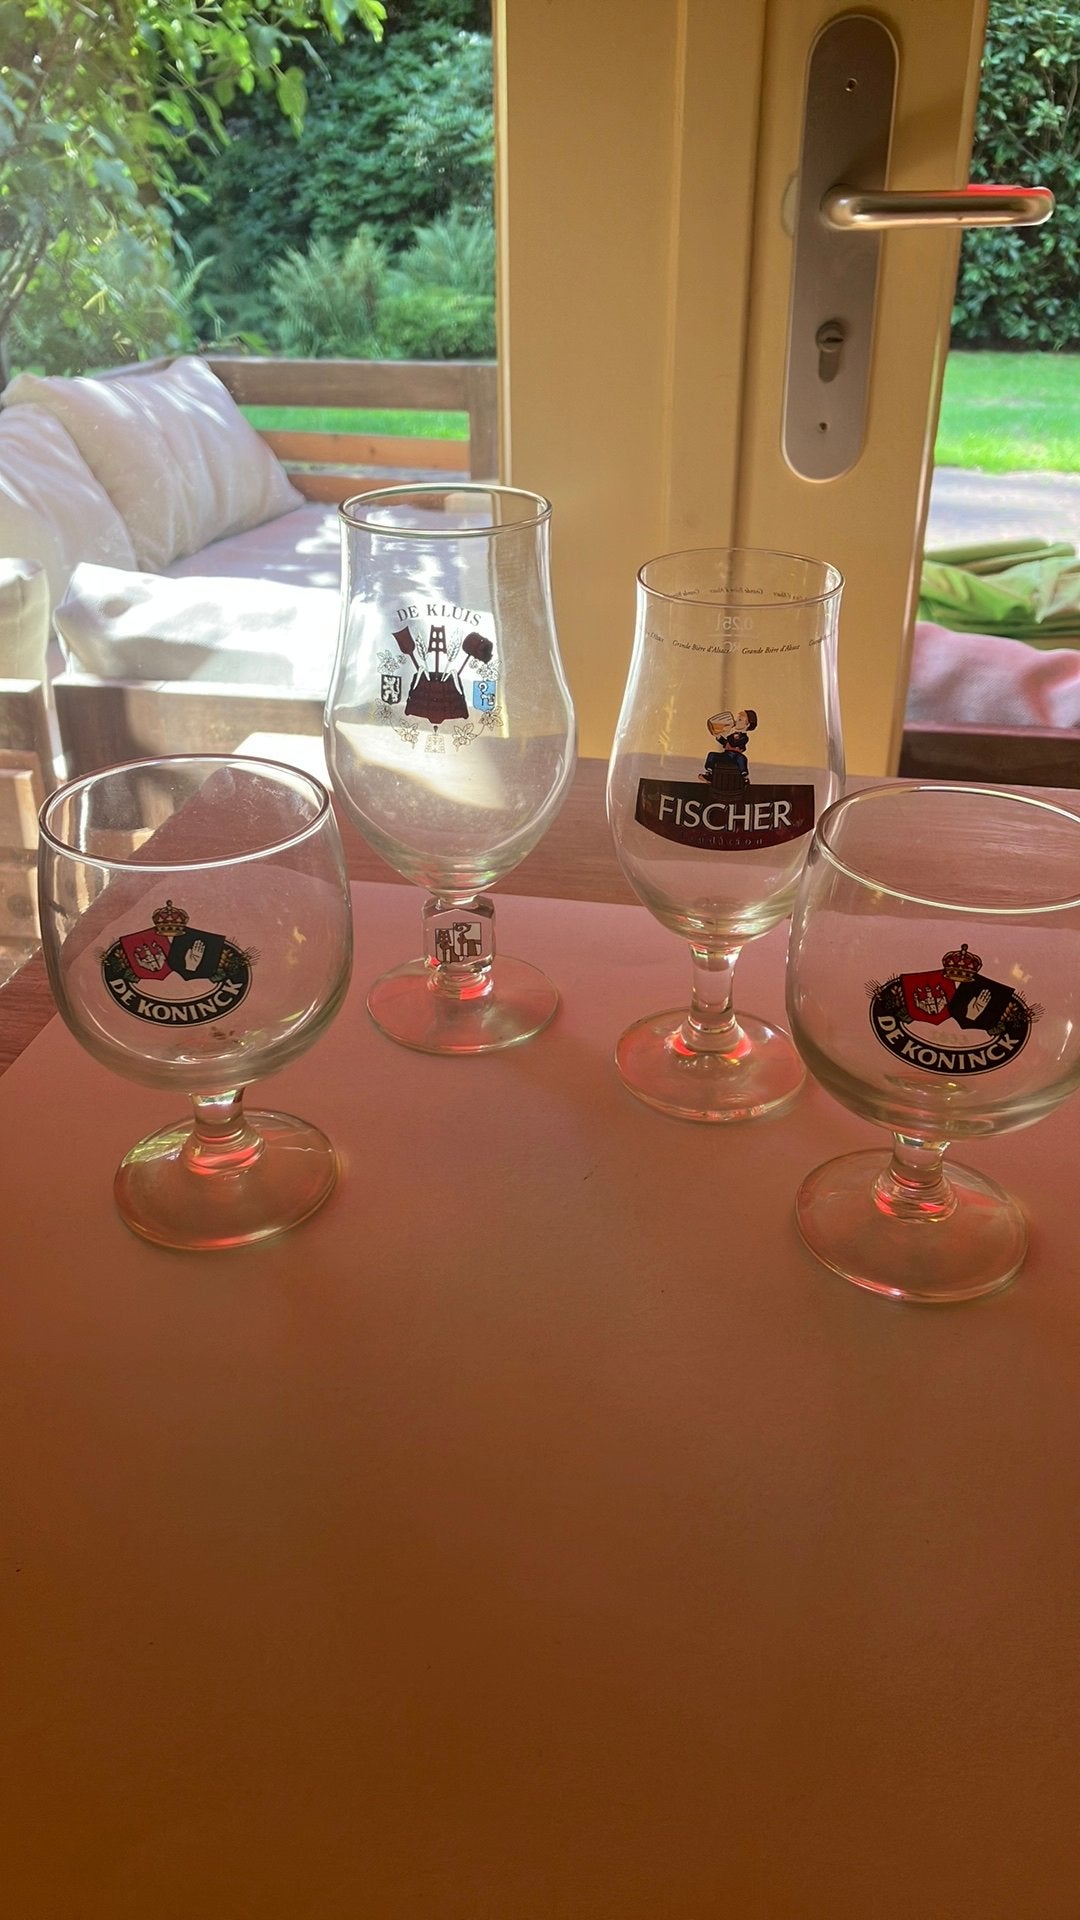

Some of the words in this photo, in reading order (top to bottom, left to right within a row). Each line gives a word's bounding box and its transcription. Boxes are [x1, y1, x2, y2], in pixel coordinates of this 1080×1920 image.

[396, 605, 419, 622] DE
[426, 604, 481, 627] KLUIS
[741, 647, 764, 655] Grande
[658, 794, 792, 832] FISCHER
[109, 978, 136, 1006] DE
[137, 978, 243, 1022] KONINCK
[877, 1015, 905, 1045] DE
[901, 1033, 1019, 1070] KONINCK
